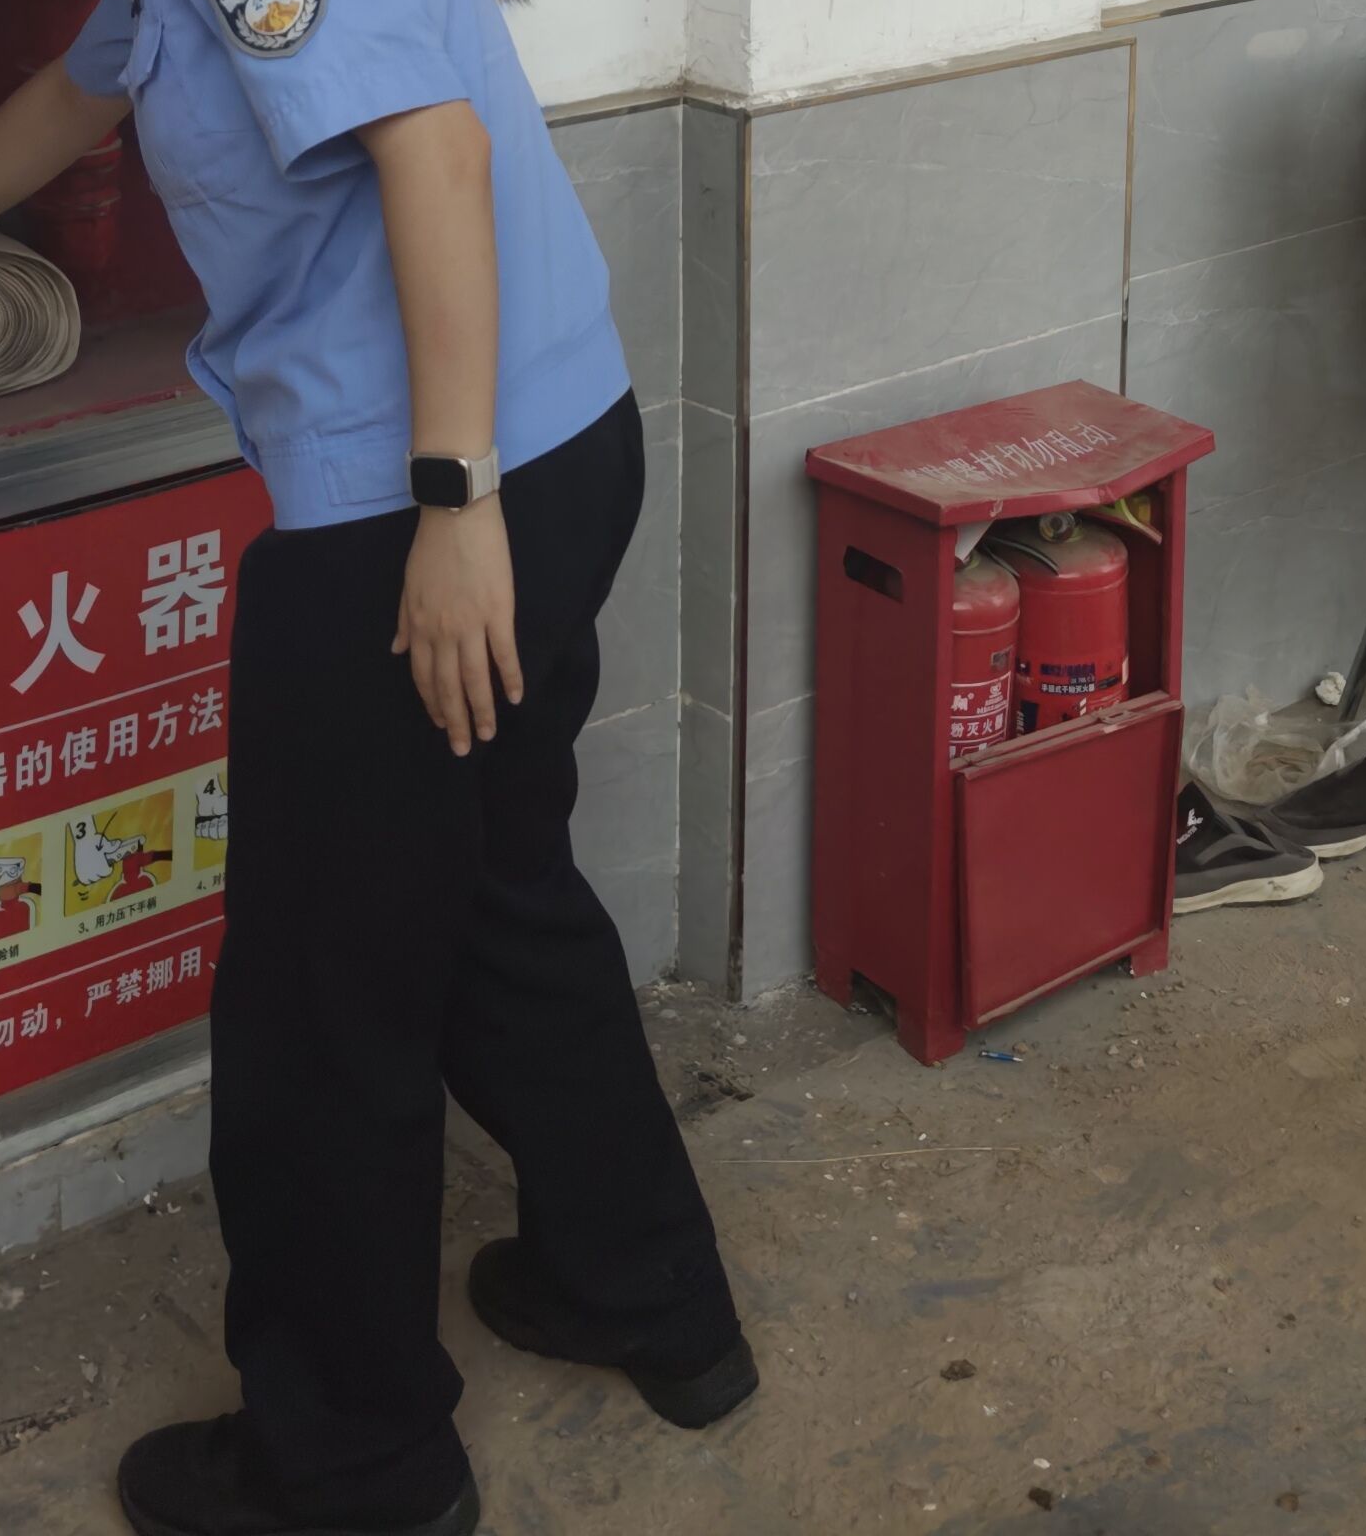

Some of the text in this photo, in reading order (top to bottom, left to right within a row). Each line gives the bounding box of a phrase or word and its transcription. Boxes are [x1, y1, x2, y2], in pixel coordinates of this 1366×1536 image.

[202, 779, 216, 795] 4
[75, 822, 88, 839] 3
[196, 869, 227, 892] 4、对
